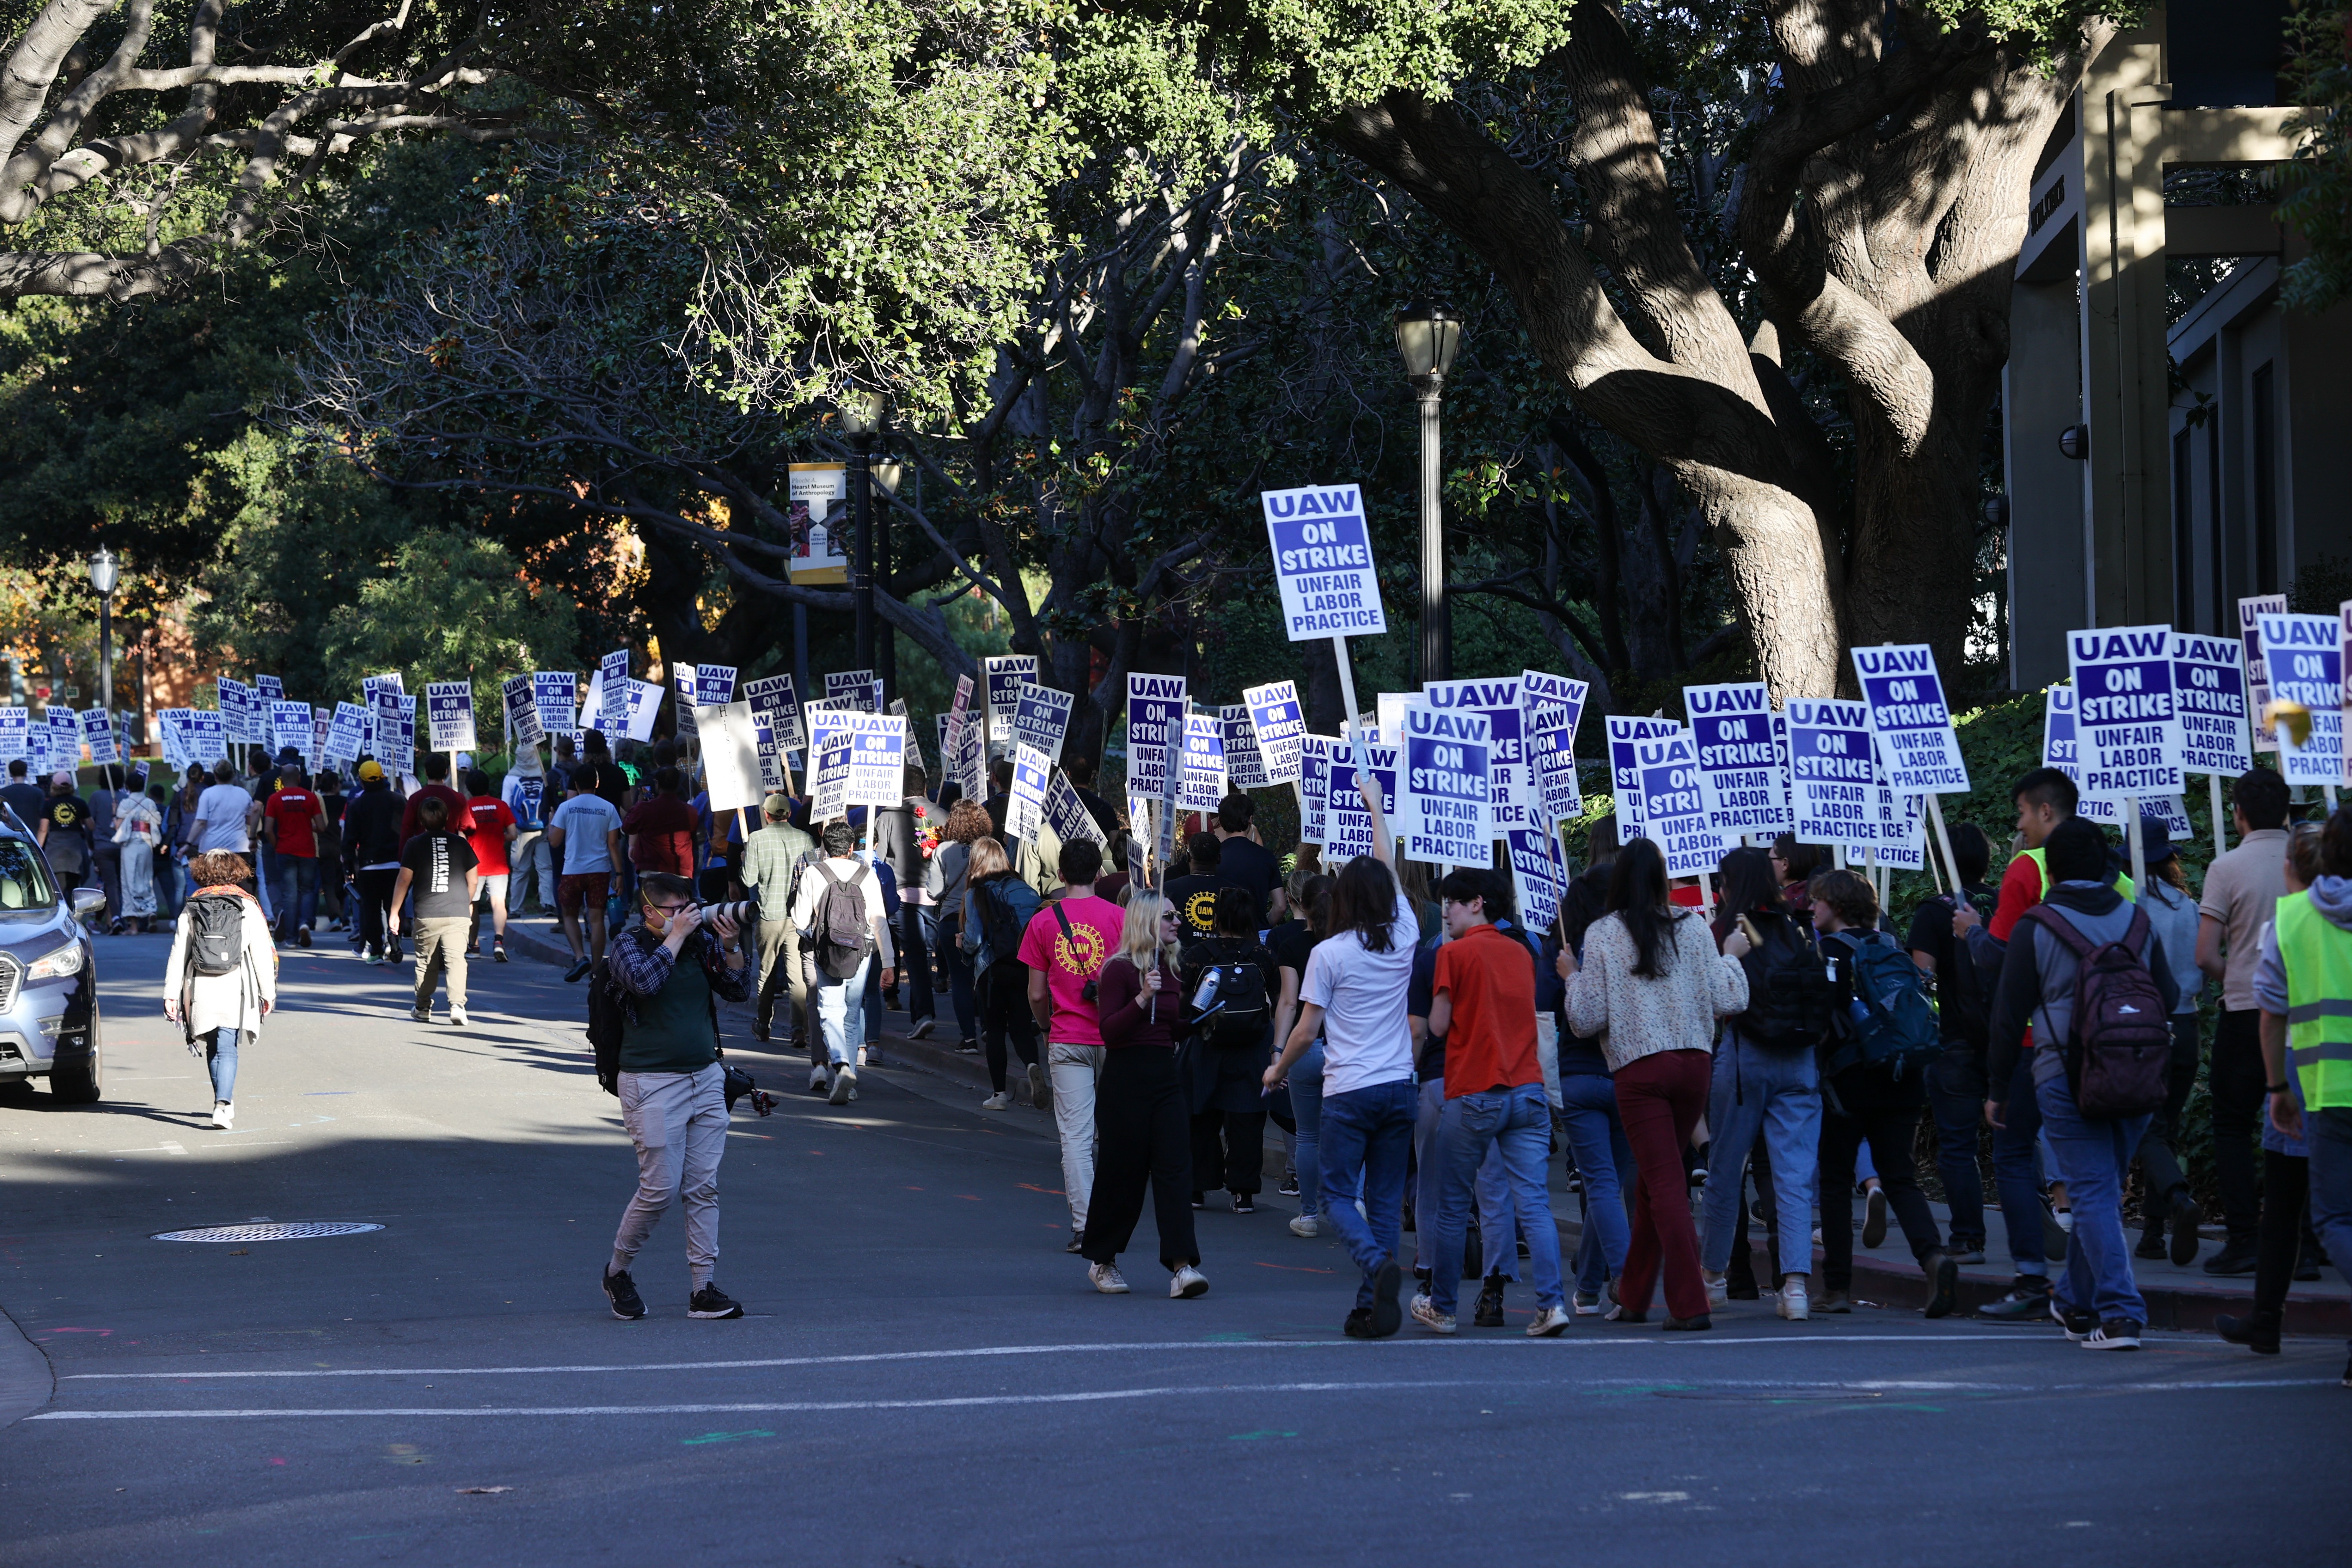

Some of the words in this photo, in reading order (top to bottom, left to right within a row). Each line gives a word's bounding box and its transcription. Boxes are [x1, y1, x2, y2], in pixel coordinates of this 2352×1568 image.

[1268, 490, 1355, 518] UAW
[1302, 521, 1336, 544] ON
[1282, 544, 1366, 570] STRIKE
[1296, 573, 1362, 594] UNFAIR
[1302, 592, 1362, 612] LABOR
[1292, 609, 1380, 632] PRACTICE
[2263, 621, 2338, 646] UAW
[2075, 632, 2166, 661] UAW
[603, 652, 626, 667] UAW
[989, 658, 1034, 672] UAW
[1858, 650, 1927, 674] UAW
[2294, 654, 2324, 678] ON
[536, 674, 573, 683] UAW
[610, 666, 619, 677] ON
[675, 665, 692, 679] UAW
[698, 666, 733, 678] UAW
[828, 673, 870, 686] UAW
[2106, 667, 2141, 691] ON
[2191, 668, 2218, 688] ON
[219, 679, 246, 692] UAW
[379, 681, 398, 694] UAW
[429, 684, 468, 696] UAW
[504, 677, 526, 695] UAW
[603, 675, 625, 689] STRIKE
[681, 681, 690, 694] ON
[707, 681, 720, 690] ON
[746, 677, 789, 695] UAW
[958, 678, 972, 695] UAW
[1004, 676, 1021, 688] ON
[1131, 677, 1182, 698] UAW
[1525, 675, 1584, 699] UAW
[228, 692, 238, 702] ON
[515, 692, 525, 704] ON
[548, 686, 562, 695] ON
[677, 692, 695, 705] STRIKE
[1022, 686, 1071, 707] UAW
[1248, 685, 1292, 707] UAW
[1430, 684, 1517, 707] UAW
[1890, 680, 1918, 701] ON
[221, 700, 246, 713] STRIKE
[273, 704, 308, 712] UAW
[384, 697, 392, 707] ON
[442, 698, 457, 708] ON
[538, 696, 573, 705] STRIKE
[763, 695, 780, 707] ON
[1690, 689, 1763, 713] UAW
[2082, 693, 2170, 720] STRIKE
[2176, 688, 2241, 713] STRIKE
[47, 708, 73, 717] UAW
[83, 710, 105, 721] UAW
[339, 704, 367, 717] UAW
[381, 707, 399, 718] STRIKE
[432, 709, 469, 720] STRIKE
[512, 701, 535, 718] STRIKE
[603, 702, 626, 716] PRACTICE
[1034, 706, 1054, 720] ON
[1146, 704, 1166, 721] ON
[1268, 706, 1287, 721] ON
[1791, 704, 1867, 727] UAW
[1876, 703, 1944, 726] STRIKE
[93, 721, 102, 730] ON
[285, 714, 299, 723] ON
[344, 716, 355, 725] ON
[438, 722, 466, 730] UNFAIR
[518, 714, 536, 727] UNFAIR
[853, 719, 902, 732] UAW
[1017, 716, 1063, 734] STRIKE
[1409, 711, 1487, 741] UAW
[2183, 716, 2236, 735] UNFAIR
[89, 729, 110, 739] STRIKE
[276, 722, 310, 732] STRIKE
[334, 722, 361, 735] STRIKE
[439, 731, 466, 739] LABOR
[521, 723, 538, 735] LABOR
[1260, 718, 1303, 740] STRIKE
[1718, 719, 1747, 740] ON
[434, 739, 473, 748] PRACTICE
[521, 729, 544, 745] PRACTICE
[822, 733, 853, 750] UAW
[868, 736, 886, 749] ON
[1020, 732, 1056, 745] UNFAIR
[1191, 737, 1209, 752] ON
[1817, 734, 1846, 754] ON
[1890, 732, 1944, 749] UNFAIR
[2095, 726, 2163, 747] UNFAIR
[2187, 734, 2235, 752] LABOR
[830, 751, 842, 765] ON
[853, 750, 900, 764] STRIKE
[1019, 747, 1048, 771] UAW
[1434, 745, 1463, 768] ON
[1701, 742, 1772, 766] STRIKE
[1898, 750, 1947, 767] LABOR
[2100, 747, 2162, 768] LABOR
[818, 764, 848, 781] STRIKE
[858, 767, 894, 778] UNFAIR
[1797, 756, 1870, 778] STRIKE
[859, 778, 891, 790] LABOR
[1025, 769, 1037, 784] ON
[1185, 771, 1219, 784] UNFAIR
[1412, 768, 1485, 796] STRIKE
[1713, 771, 1769, 789] UNFAIR
[1892, 768, 1963, 786] PRACTICE
[2087, 766, 2178, 790] PRACTICE
[820, 781, 843, 795] UNFAIR
[850, 789, 899, 802] PRACTICE
[1014, 779, 1042, 802] STRIKE
[1187, 783, 1217, 795] LABOR
[1807, 784, 1864, 801] UNFAIR
[820, 792, 841, 806] LABOR
[1015, 797, 1037, 816] UNFAIR
[1718, 790, 1769, 808] LABOR
[814, 802, 845, 818] PRACTICE
[1014, 808, 1034, 826] LABOR
[1421, 798, 1478, 820] UNFAIR
[1811, 802, 1862, 819] LABOR
[1709, 808, 1784, 827] PRACTICE
[1008, 818, 1037, 839] PRACTICE
[1424, 818, 1475, 839] LABOR
[1801, 820, 1876, 837] PRACTICE
[1412, 836, 1488, 860] PRACTICE
[1197, 906, 1213, 916] UAW
[1069, 943, 1089, 954] UAW
